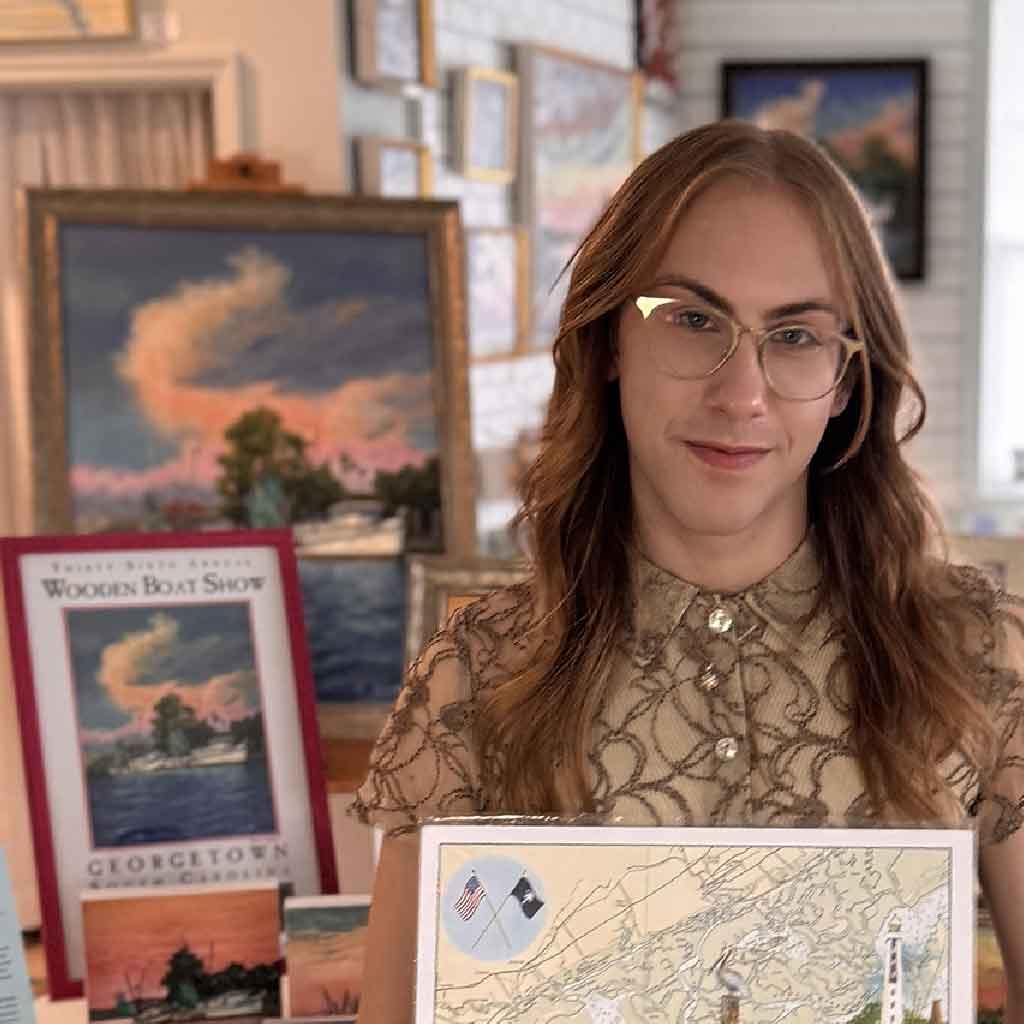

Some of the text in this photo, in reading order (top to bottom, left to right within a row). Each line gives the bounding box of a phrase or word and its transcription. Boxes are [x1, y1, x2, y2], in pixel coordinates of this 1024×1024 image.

[40, 572, 266, 599] WOODEN BOAT SHOW
[87, 845, 288, 876] GEORGETOWN
